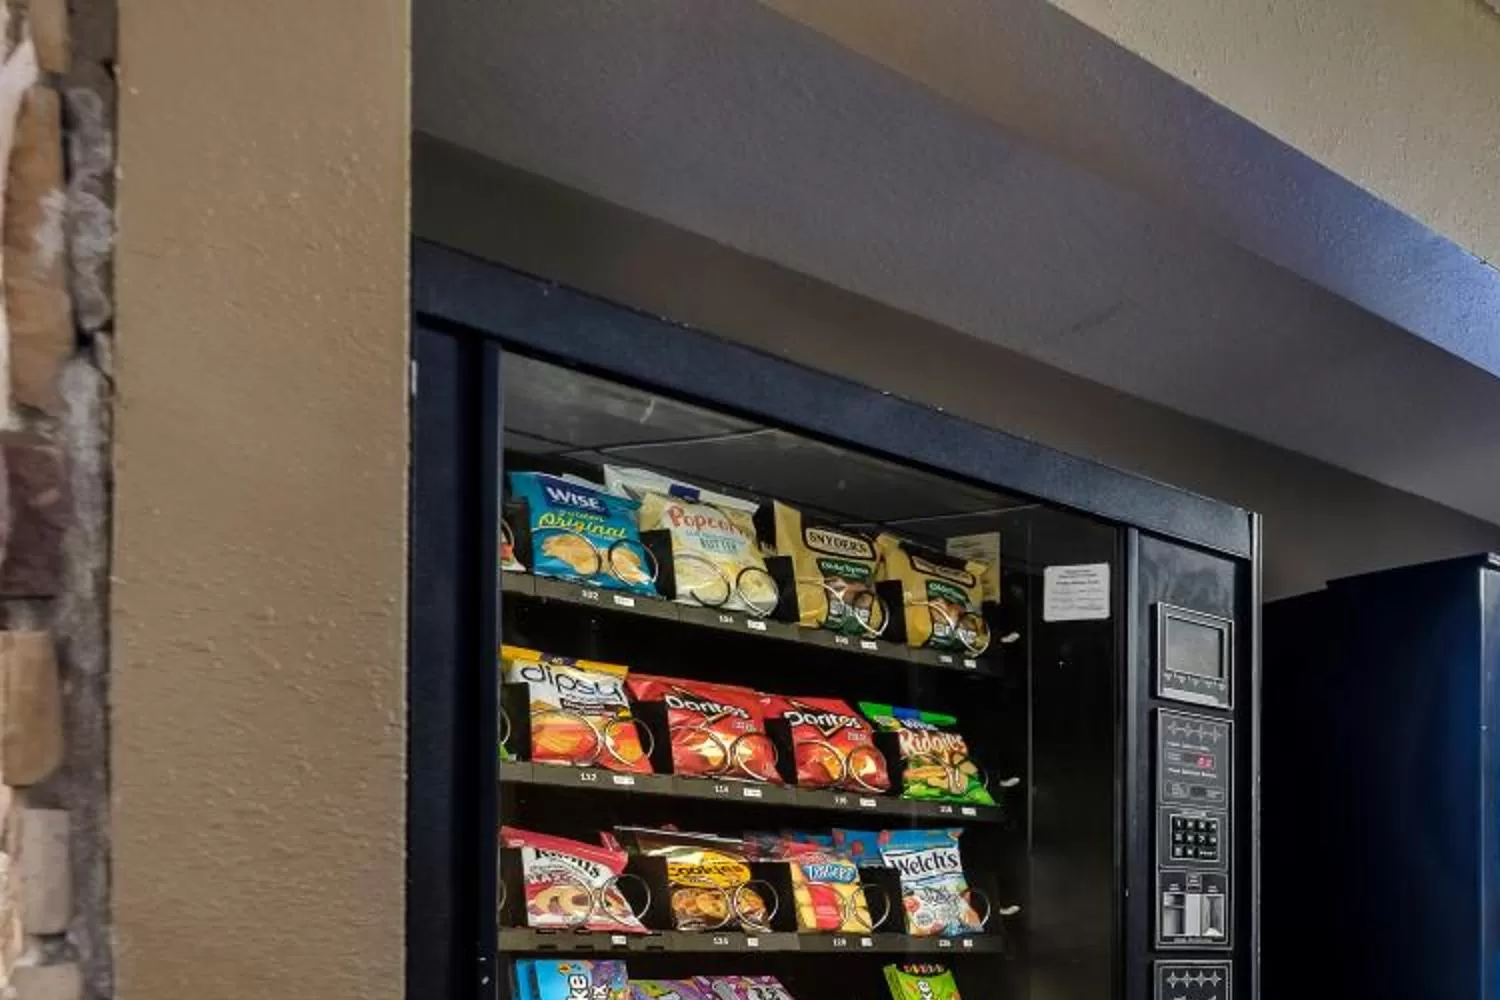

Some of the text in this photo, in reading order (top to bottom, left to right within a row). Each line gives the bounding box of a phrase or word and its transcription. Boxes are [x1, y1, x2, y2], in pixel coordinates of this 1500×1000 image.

[665, 695, 749, 719] Doritos
[784, 711, 862, 729] Doritos
[888, 851, 959, 876] Welch's
